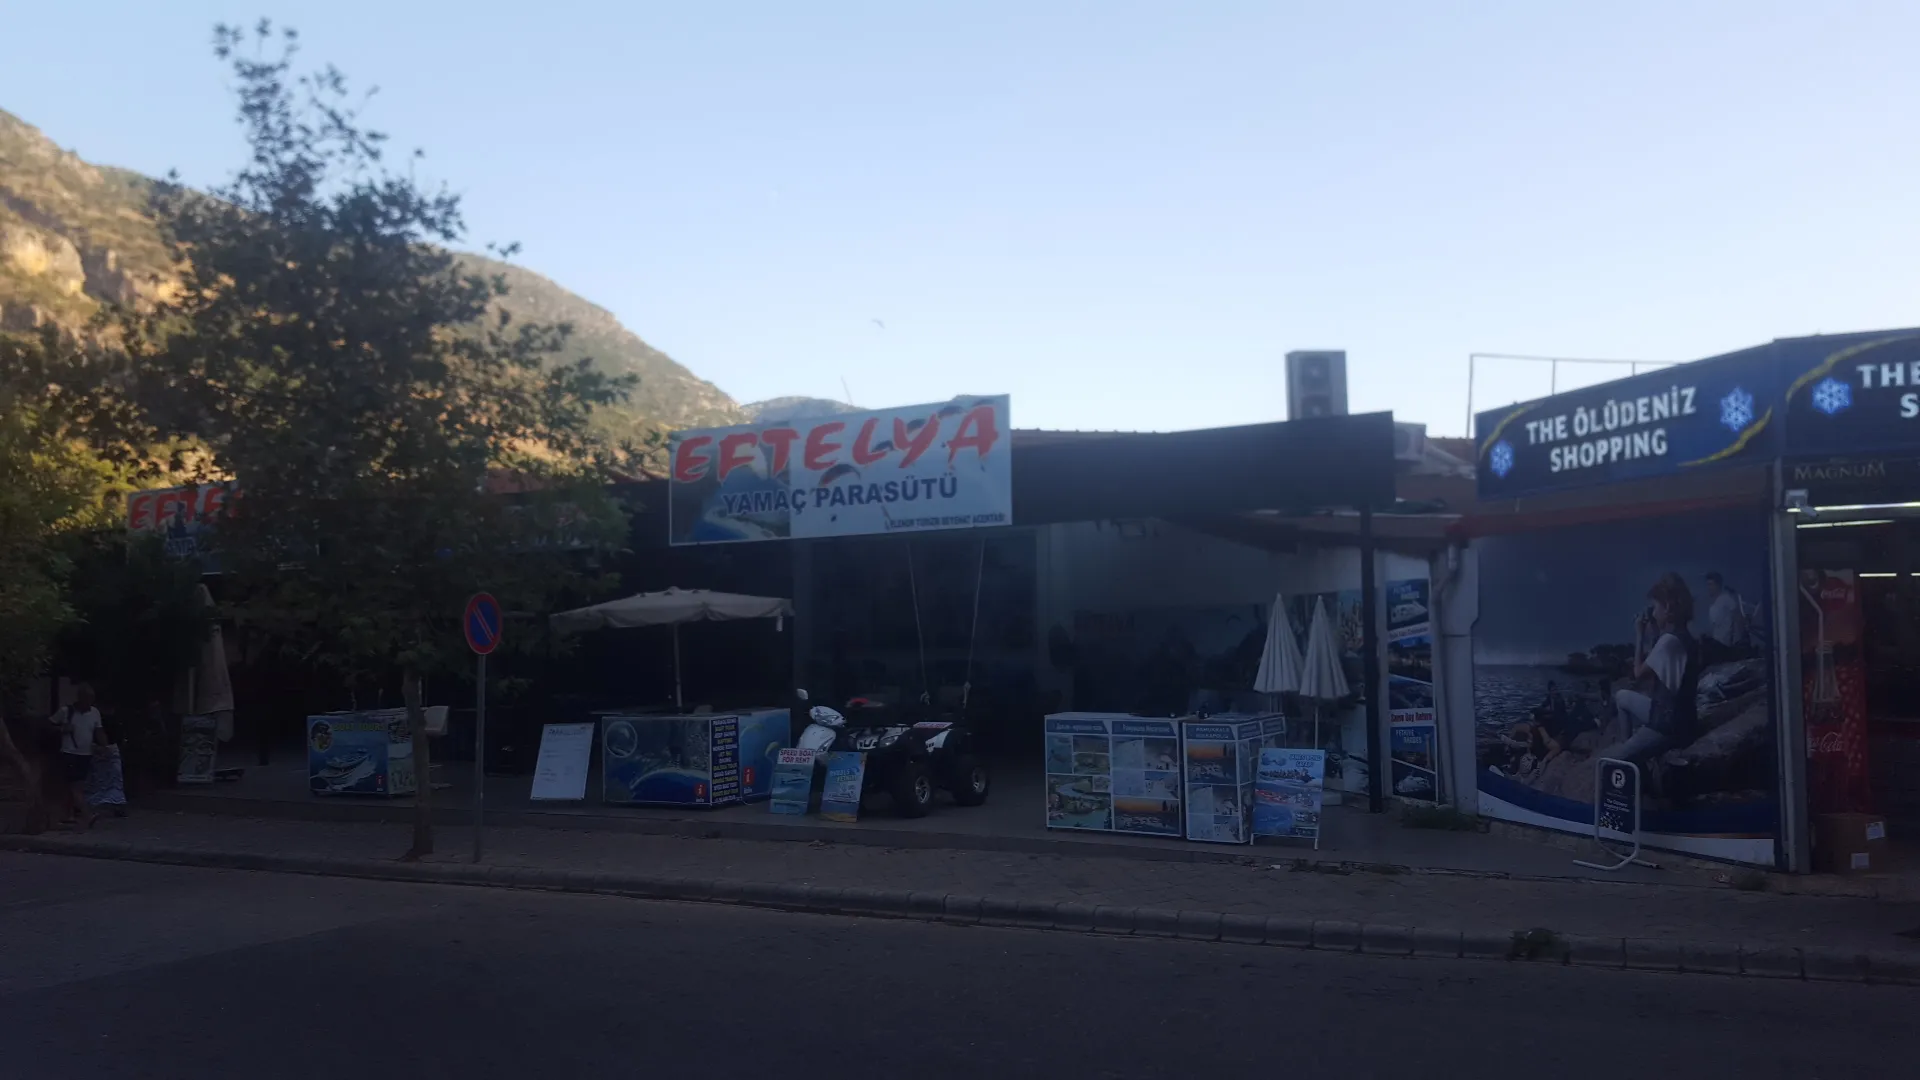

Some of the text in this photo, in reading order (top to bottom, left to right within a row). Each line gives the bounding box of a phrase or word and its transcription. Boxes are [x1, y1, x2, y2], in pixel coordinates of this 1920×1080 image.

[674, 404, 998, 484] EFTELYA
[1526, 417, 1568, 446] THE
[1550, 428, 1668, 473] SHOPPING
[723, 473, 958, 516] YAMAÇ PARASÜTÜ
